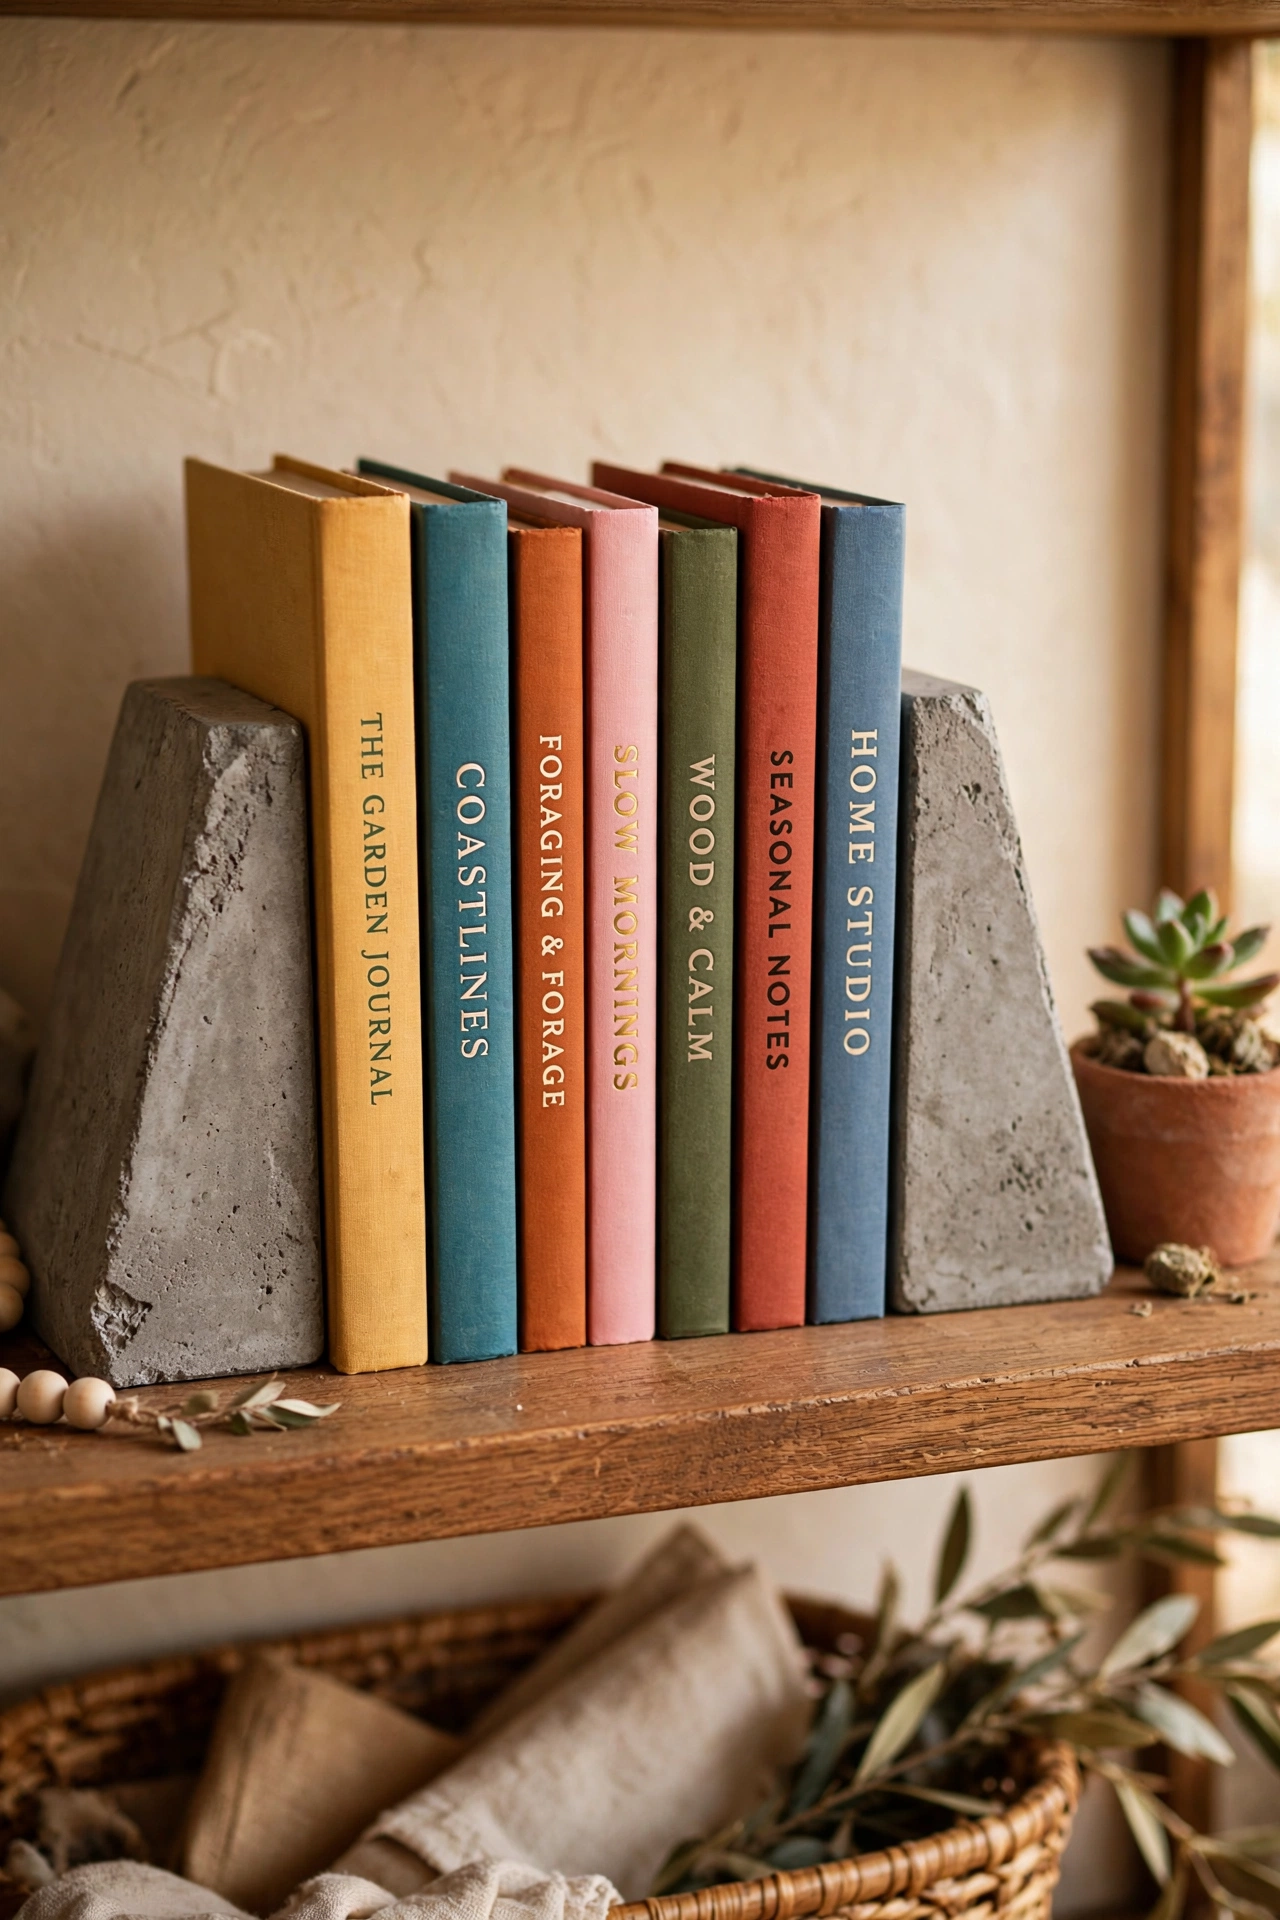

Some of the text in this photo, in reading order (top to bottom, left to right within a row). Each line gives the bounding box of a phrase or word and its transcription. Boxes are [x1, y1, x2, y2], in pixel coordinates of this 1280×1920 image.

[361, 712, 393, 1106] THE GARDEN JOURNAL
[456, 762, 489, 1059] COASTLINES
[539, 734, 565, 1108] FORAGING & FORAGE
[612, 745, 639, 1092] SLOW MORNINGS
[687, 754, 716, 1063] WOOD & CALM
[766, 750, 793, 1070] SEASONAL NOTES
[843, 728, 878, 1056] HOME STUDIO
